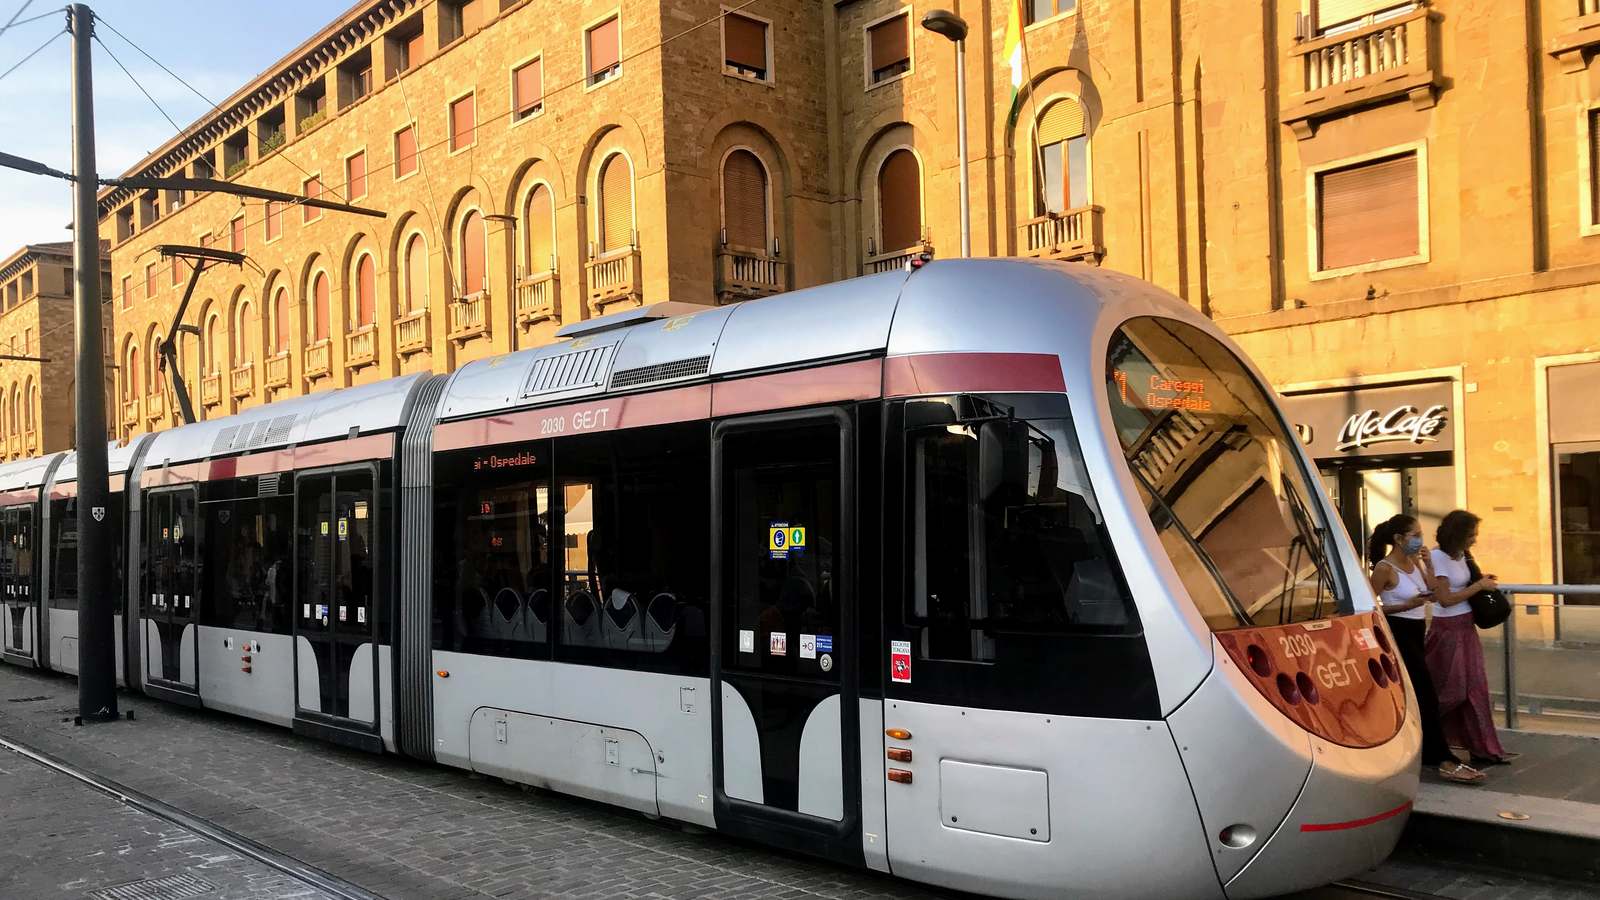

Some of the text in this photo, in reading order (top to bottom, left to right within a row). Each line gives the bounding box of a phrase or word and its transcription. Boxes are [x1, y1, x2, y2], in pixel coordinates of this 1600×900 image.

[1151, 375, 1204, 394] Careggi
[1147, 393, 1211, 411] Ospedale
[541, 408, 609, 434] 2030 GEST
[1336, 405, 1447, 449] McCafé
[490, 451, 536, 468] Ospedale
[1279, 633, 1317, 658] 2030
[1317, 659, 1362, 689] GEST
